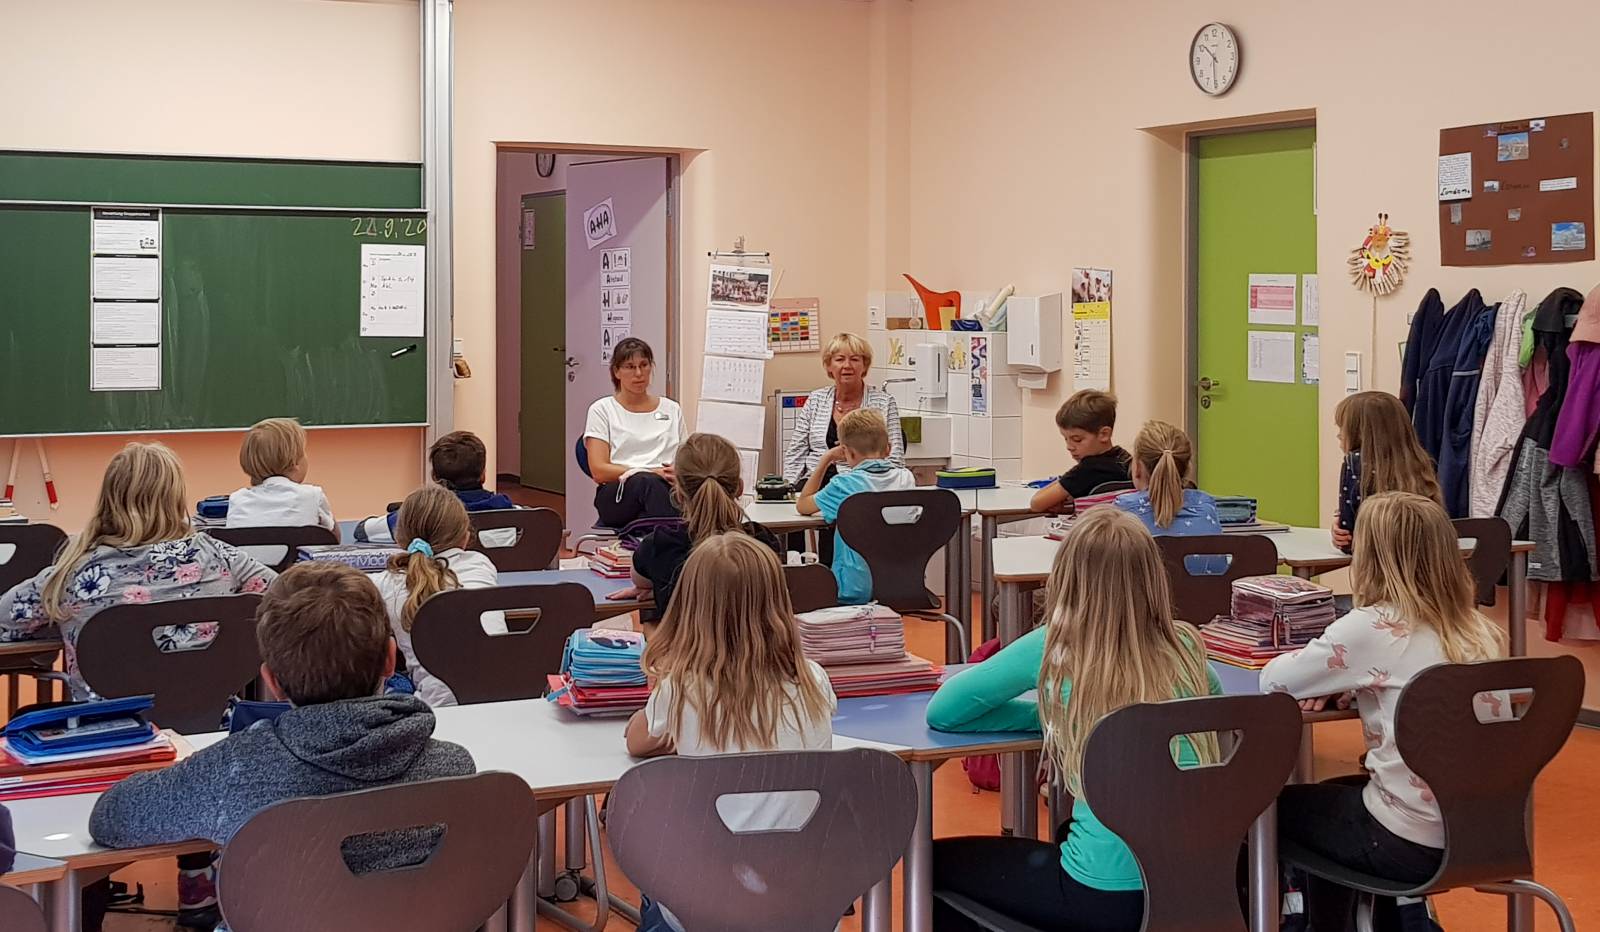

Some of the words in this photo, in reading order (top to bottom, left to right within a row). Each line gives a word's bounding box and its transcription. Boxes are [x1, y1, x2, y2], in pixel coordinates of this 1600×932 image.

[1211, 28, 1218, 37] 12
[1226, 39, 1232, 48] 2
[1230, 51, 1235, 60] 3
[1205, 77, 1210, 86] 7
[1222, 75, 1227, 84] 5
[590, 210, 609, 234] AHA
[602, 252, 610, 270] A
[602, 290, 610, 308] H
[603, 329, 611, 347] A
